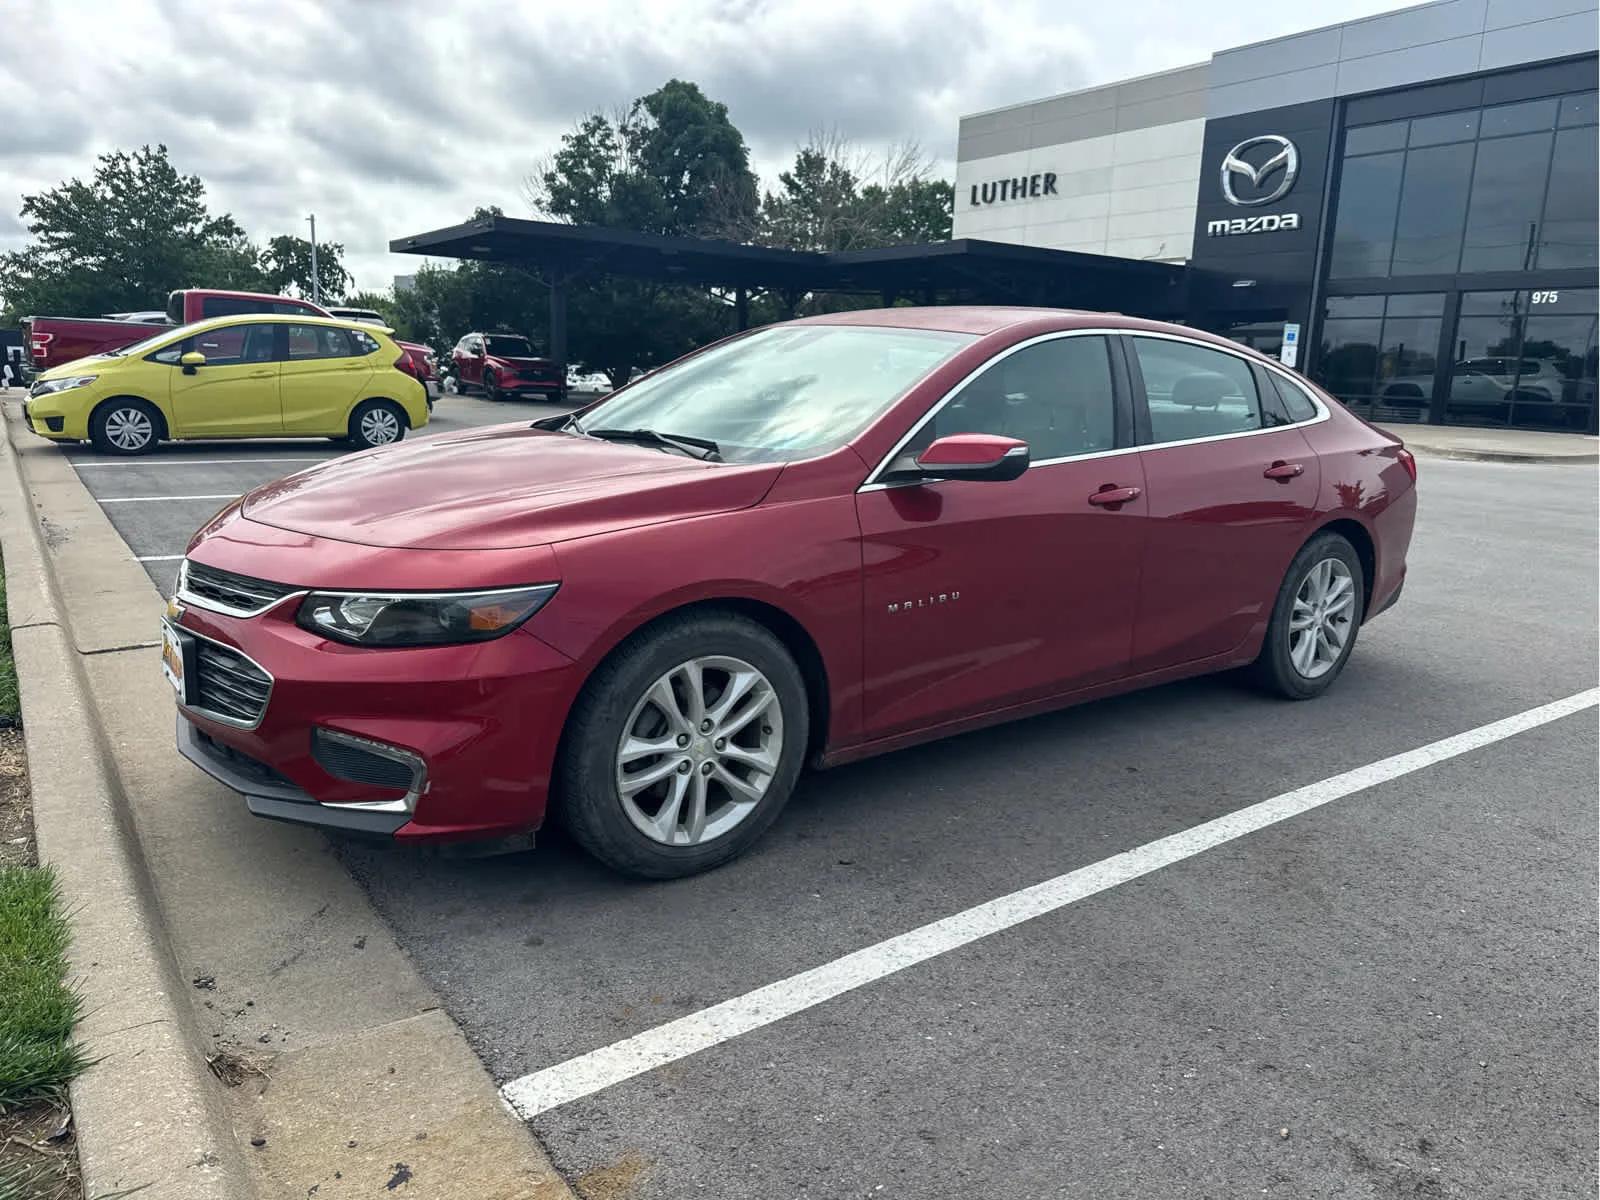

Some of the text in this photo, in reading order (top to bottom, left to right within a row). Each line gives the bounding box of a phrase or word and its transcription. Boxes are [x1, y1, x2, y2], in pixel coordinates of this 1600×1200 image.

[970, 172, 1058, 206] LUTHER
[1531, 290, 1559, 304] 975
[887, 591, 960, 615] MALIBU
